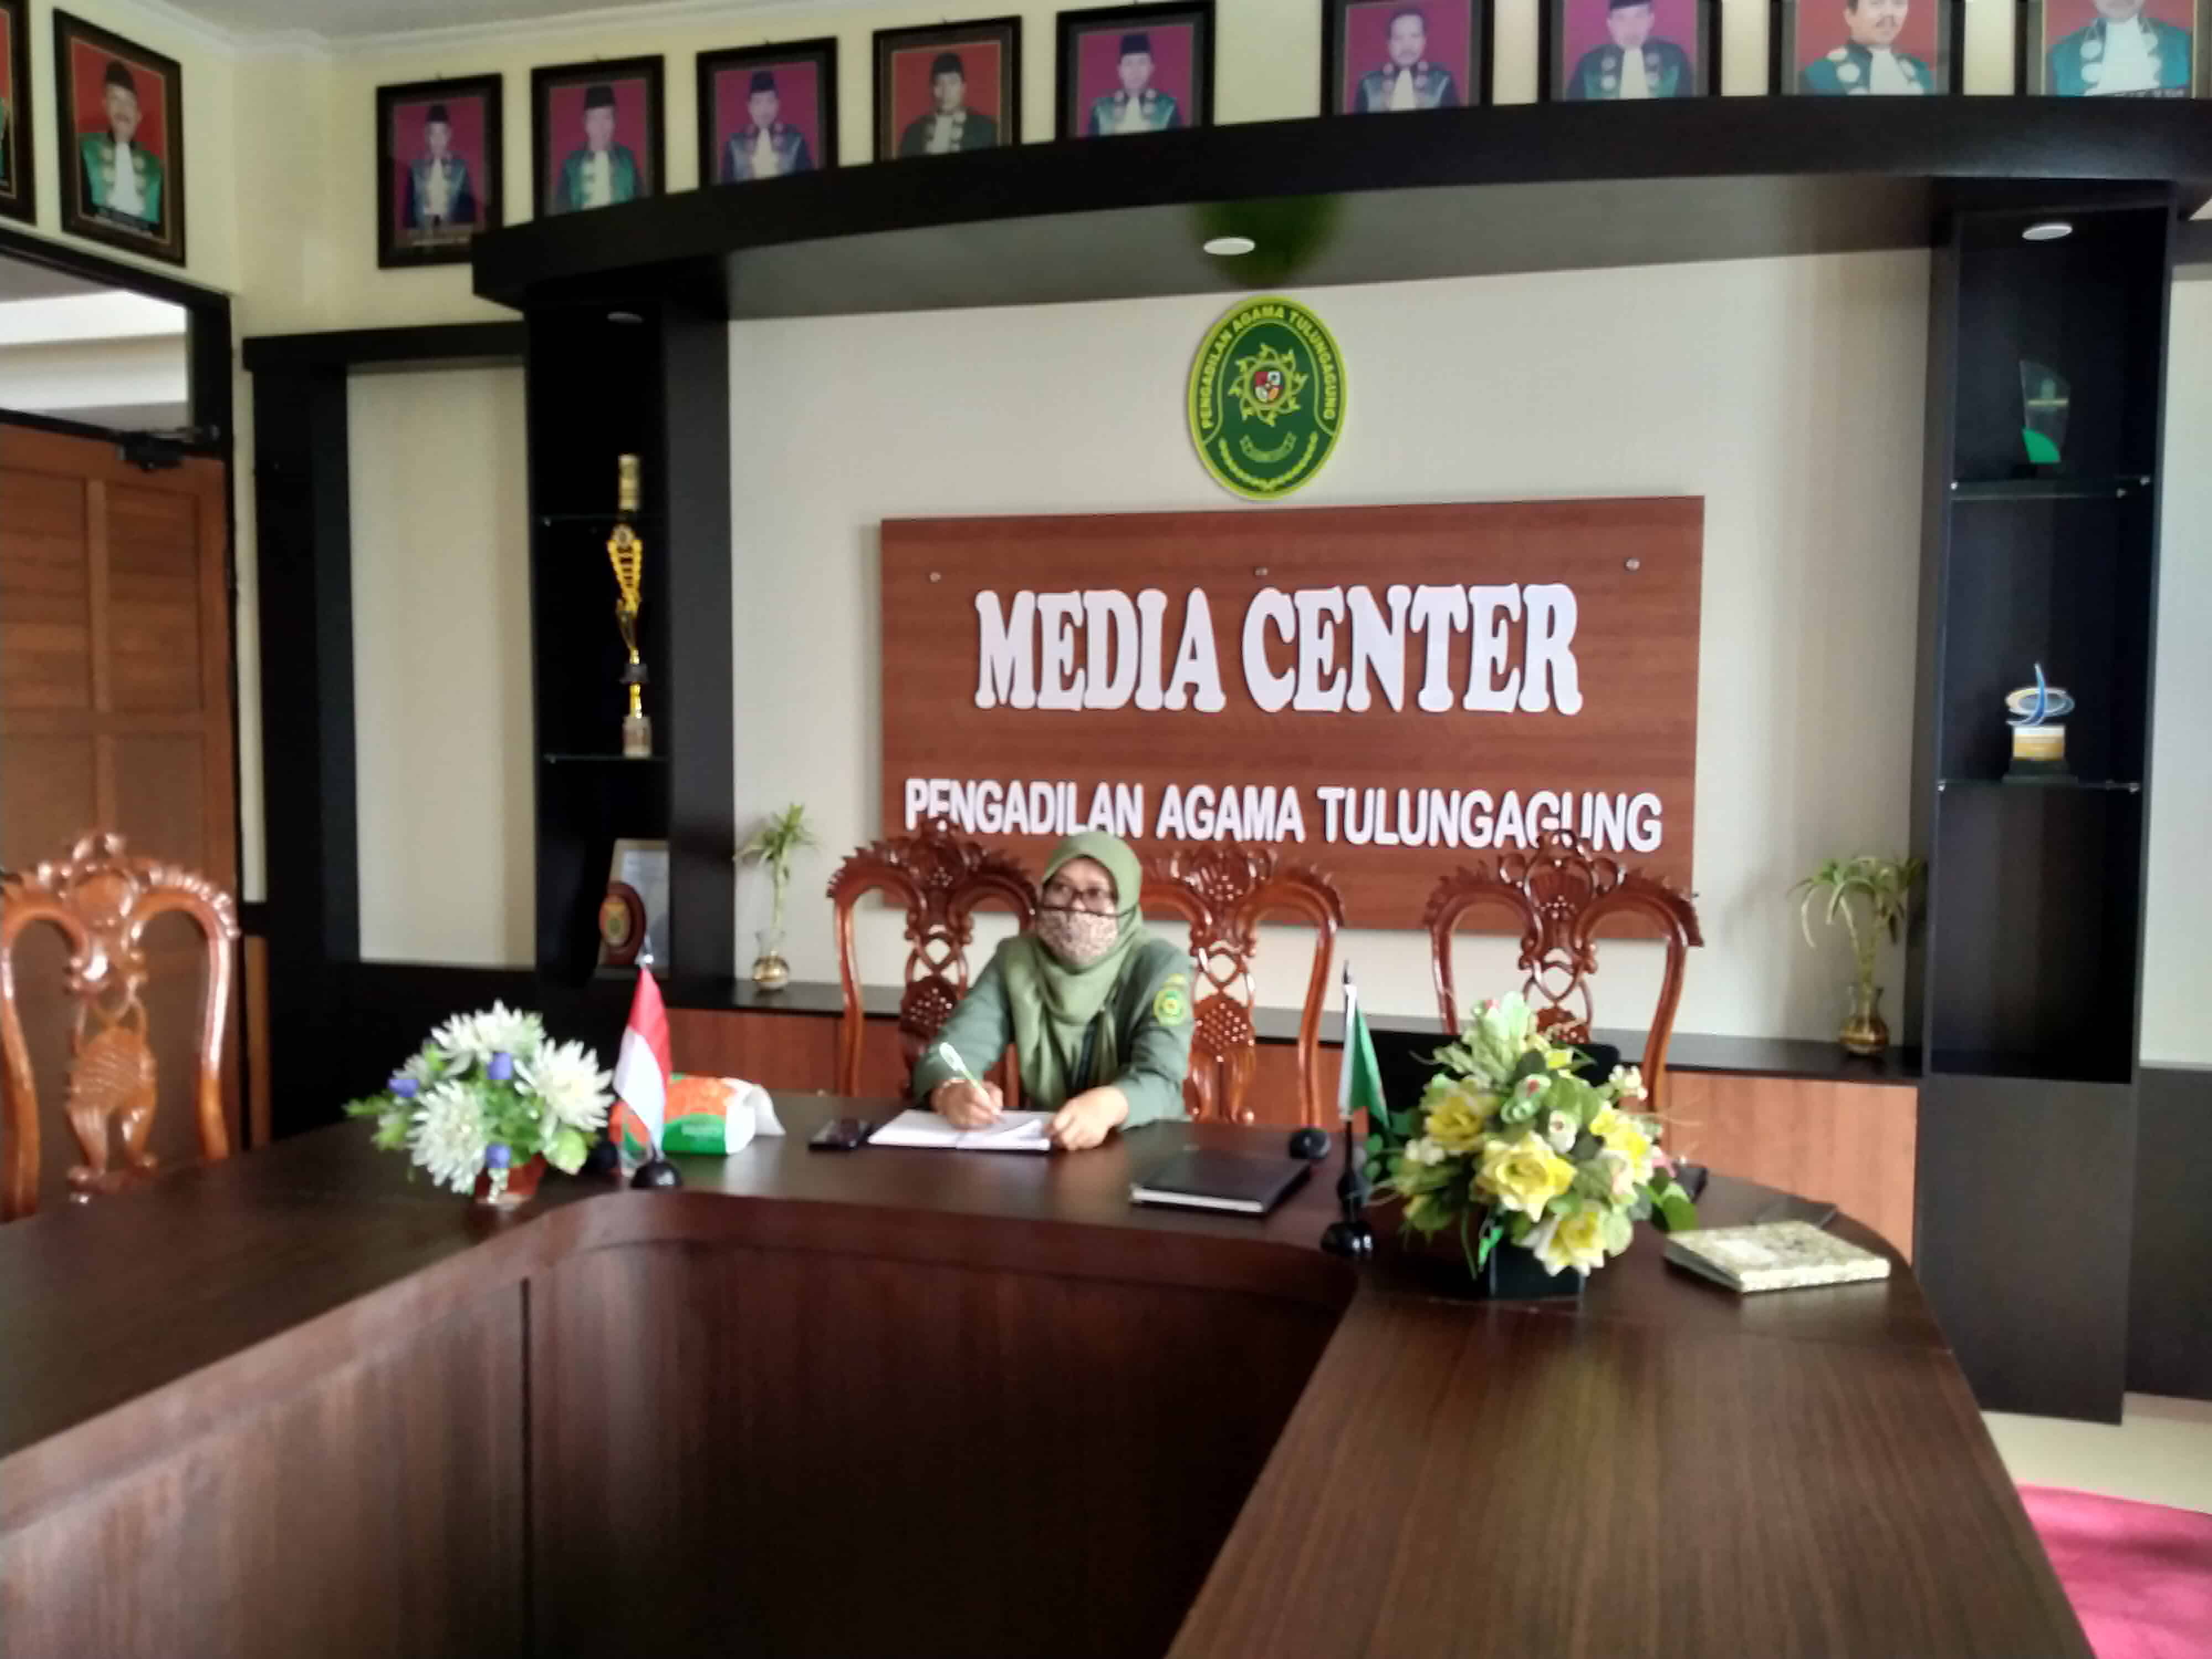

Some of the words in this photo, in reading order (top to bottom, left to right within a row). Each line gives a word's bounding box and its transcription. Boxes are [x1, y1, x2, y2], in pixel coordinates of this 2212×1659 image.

[1233, 306, 1284, 332] AGAMA
[974, 587, 1227, 713] MEDIA
[1242, 582, 1584, 716] CENTER
[905, 778, 1144, 838] PENGADILAN
[1156, 784, 1306, 843] AGAMA
[1316, 786, 1663, 853] TULUNGAGUNG
